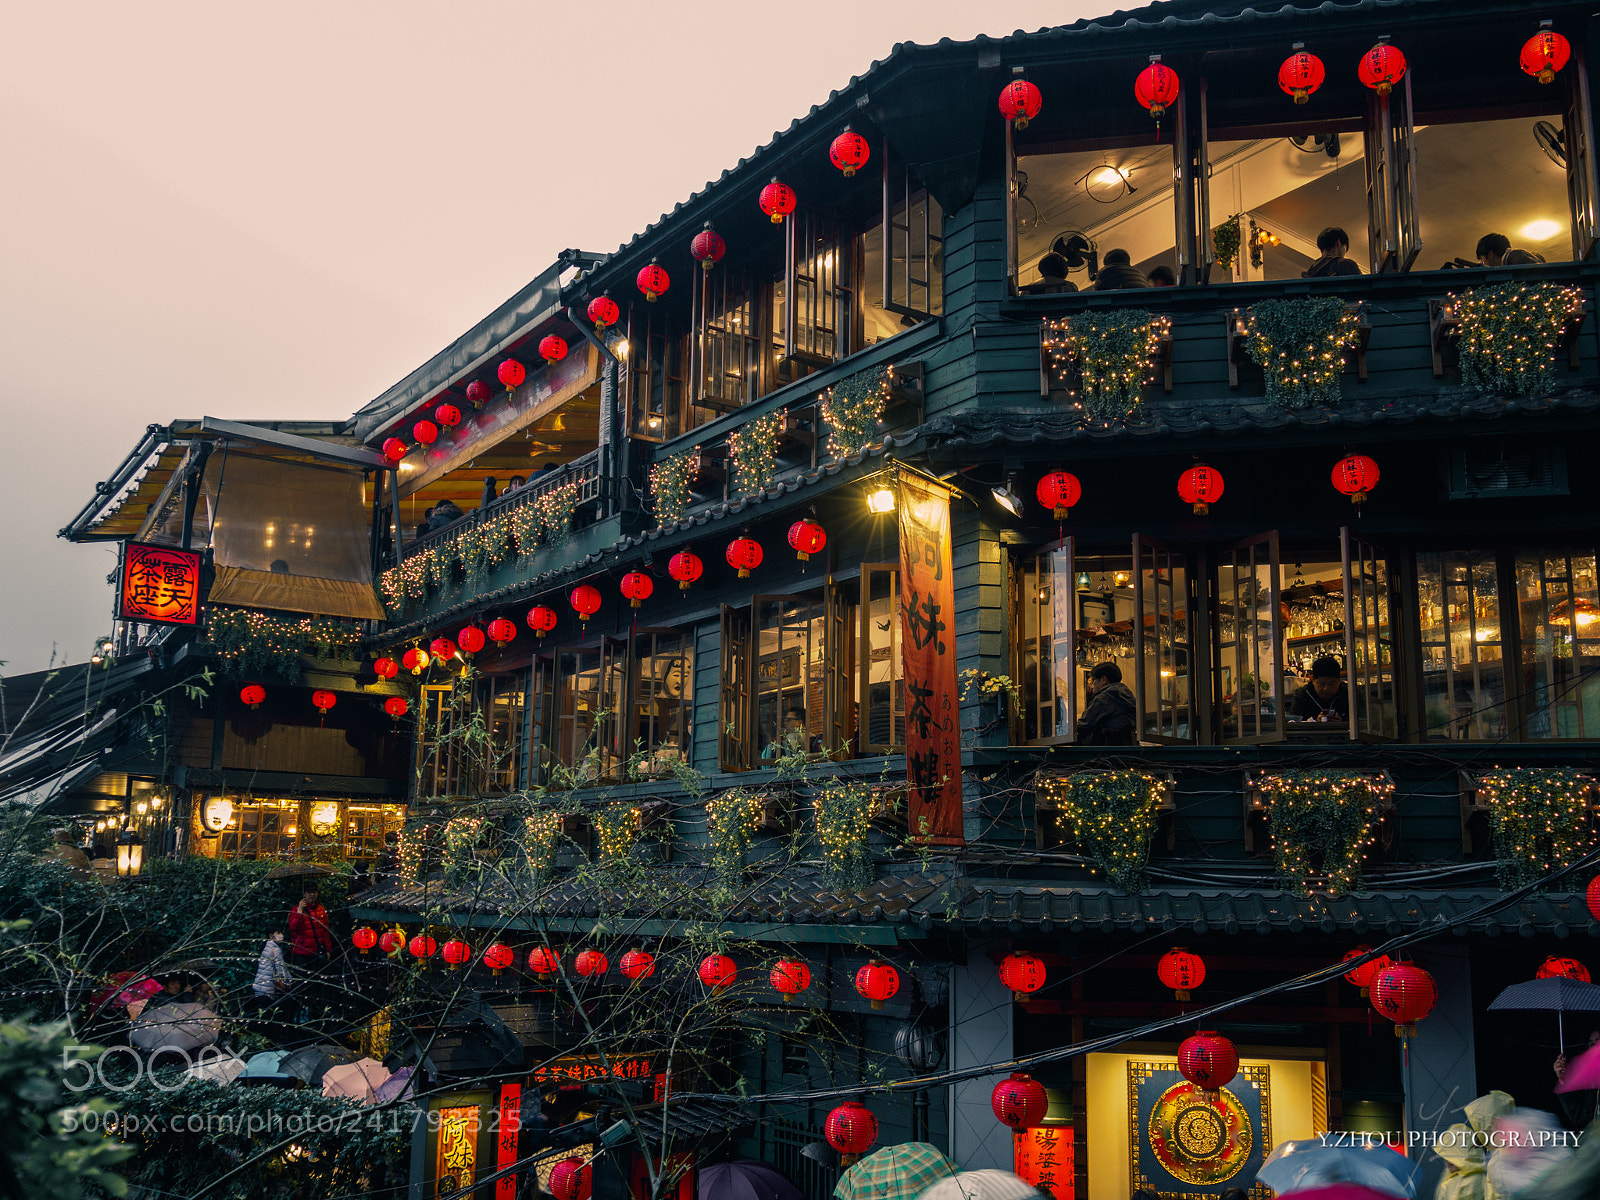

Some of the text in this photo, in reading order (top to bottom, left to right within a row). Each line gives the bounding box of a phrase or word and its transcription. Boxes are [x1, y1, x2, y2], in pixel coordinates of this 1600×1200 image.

[130, 557, 195, 608] 露天 茶座
[902, 529, 946, 804] 阿妹茶樓
[941, 691, 958, 798] あめおちゃ
[1383, 974, 1400, 1013] 九份
[1193, 1046, 1210, 1082] 九份
[442, 1115, 475, 1169] 阿妹
[1035, 1128, 1061, 1188] 湯婆婆
